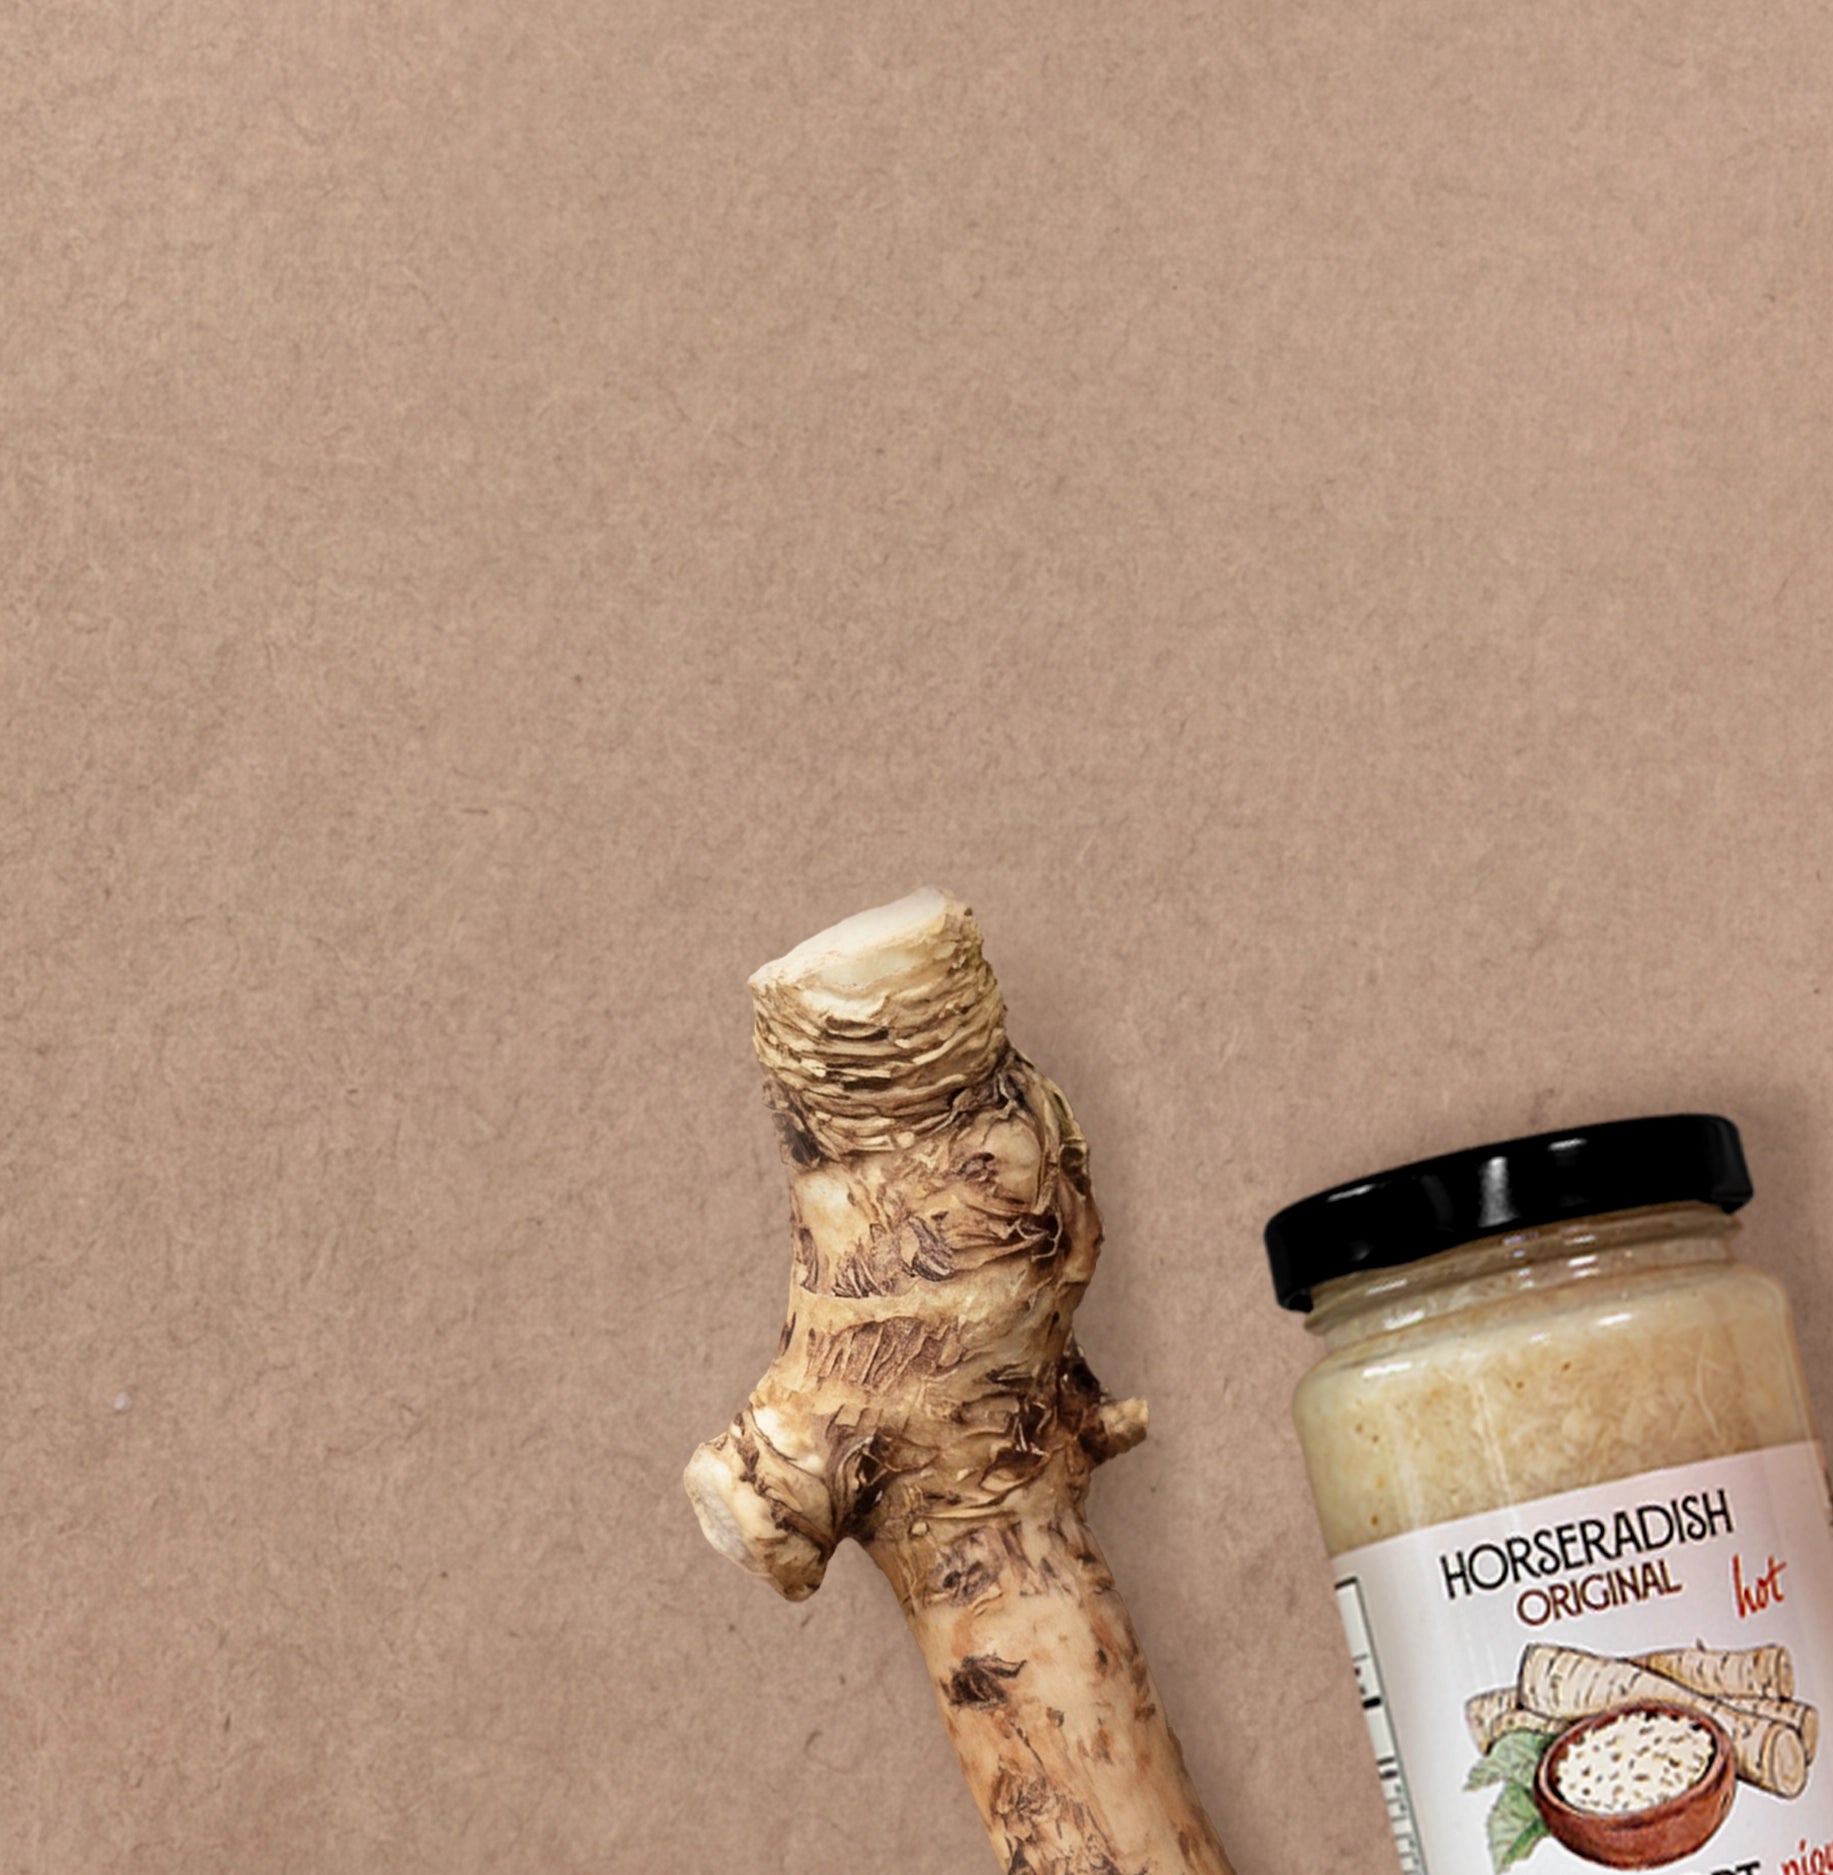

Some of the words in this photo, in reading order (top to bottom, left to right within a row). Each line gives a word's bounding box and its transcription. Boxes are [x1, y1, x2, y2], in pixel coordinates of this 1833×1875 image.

[1439, 1488, 1735, 1602] HORSERADISH
[1515, 1559, 1684, 1627] ORIGINAL
[1732, 1552, 1787, 1619] hot
